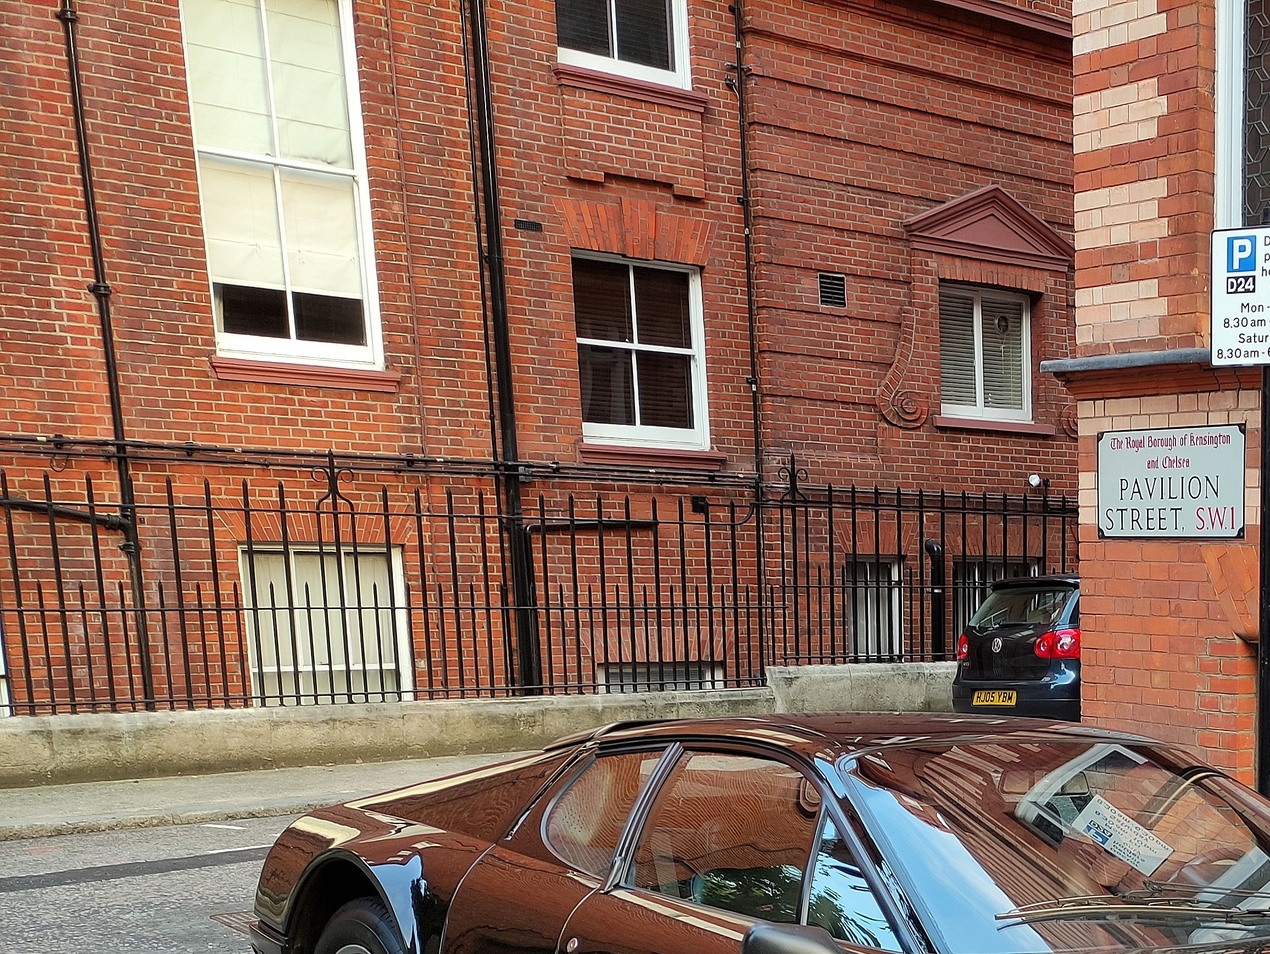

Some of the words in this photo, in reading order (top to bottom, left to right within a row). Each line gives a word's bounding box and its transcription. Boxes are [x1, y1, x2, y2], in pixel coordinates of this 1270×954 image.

[1232, 238, 1252, 270] P
[1228, 277, 1254, 292] D24
[1240, 302, 1264, 313] Mon
[1110, 437, 1122, 450] The
[1125, 435, 1145, 452] Royal
[1148, 435, 1176, 450] Borough
[1180, 434, 1188, 446] of
[1190, 432, 1231, 449] Kensington
[1146, 456, 1158, 470] and
[1162, 456, 1190, 469] Chelsea
[1119, 475, 1220, 500] PAVILION
[1105, 507, 1185, 532] STREET,
[976, 692, 995, 702] HJ05
[996, 692, 1014, 702] YBM
